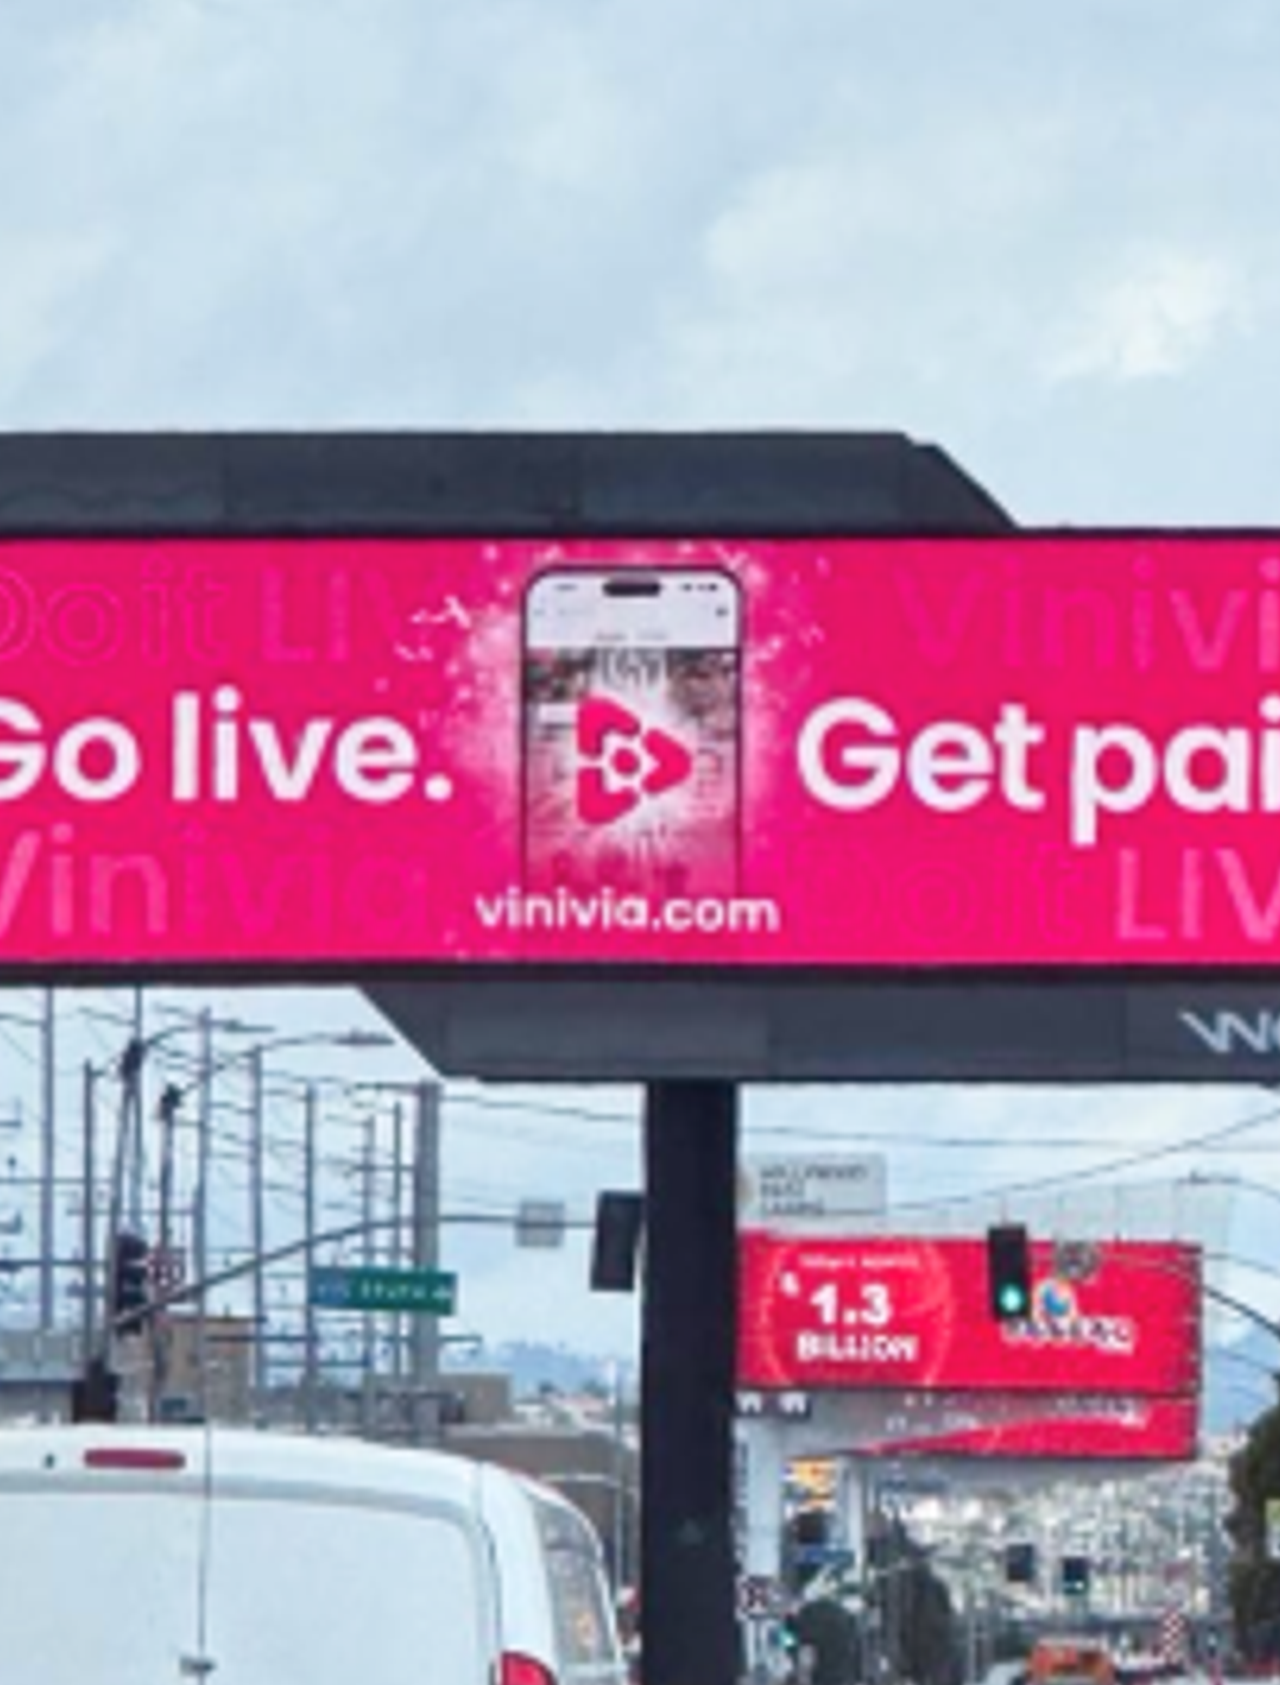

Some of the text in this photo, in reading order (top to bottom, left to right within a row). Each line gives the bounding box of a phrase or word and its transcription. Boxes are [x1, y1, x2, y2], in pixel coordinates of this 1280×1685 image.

[171, 684, 453, 803] live.
[796, 696, 1046, 812] Get
[474, 886, 781, 932] vinivia.com
[796, 1331, 919, 1363] BILLION
